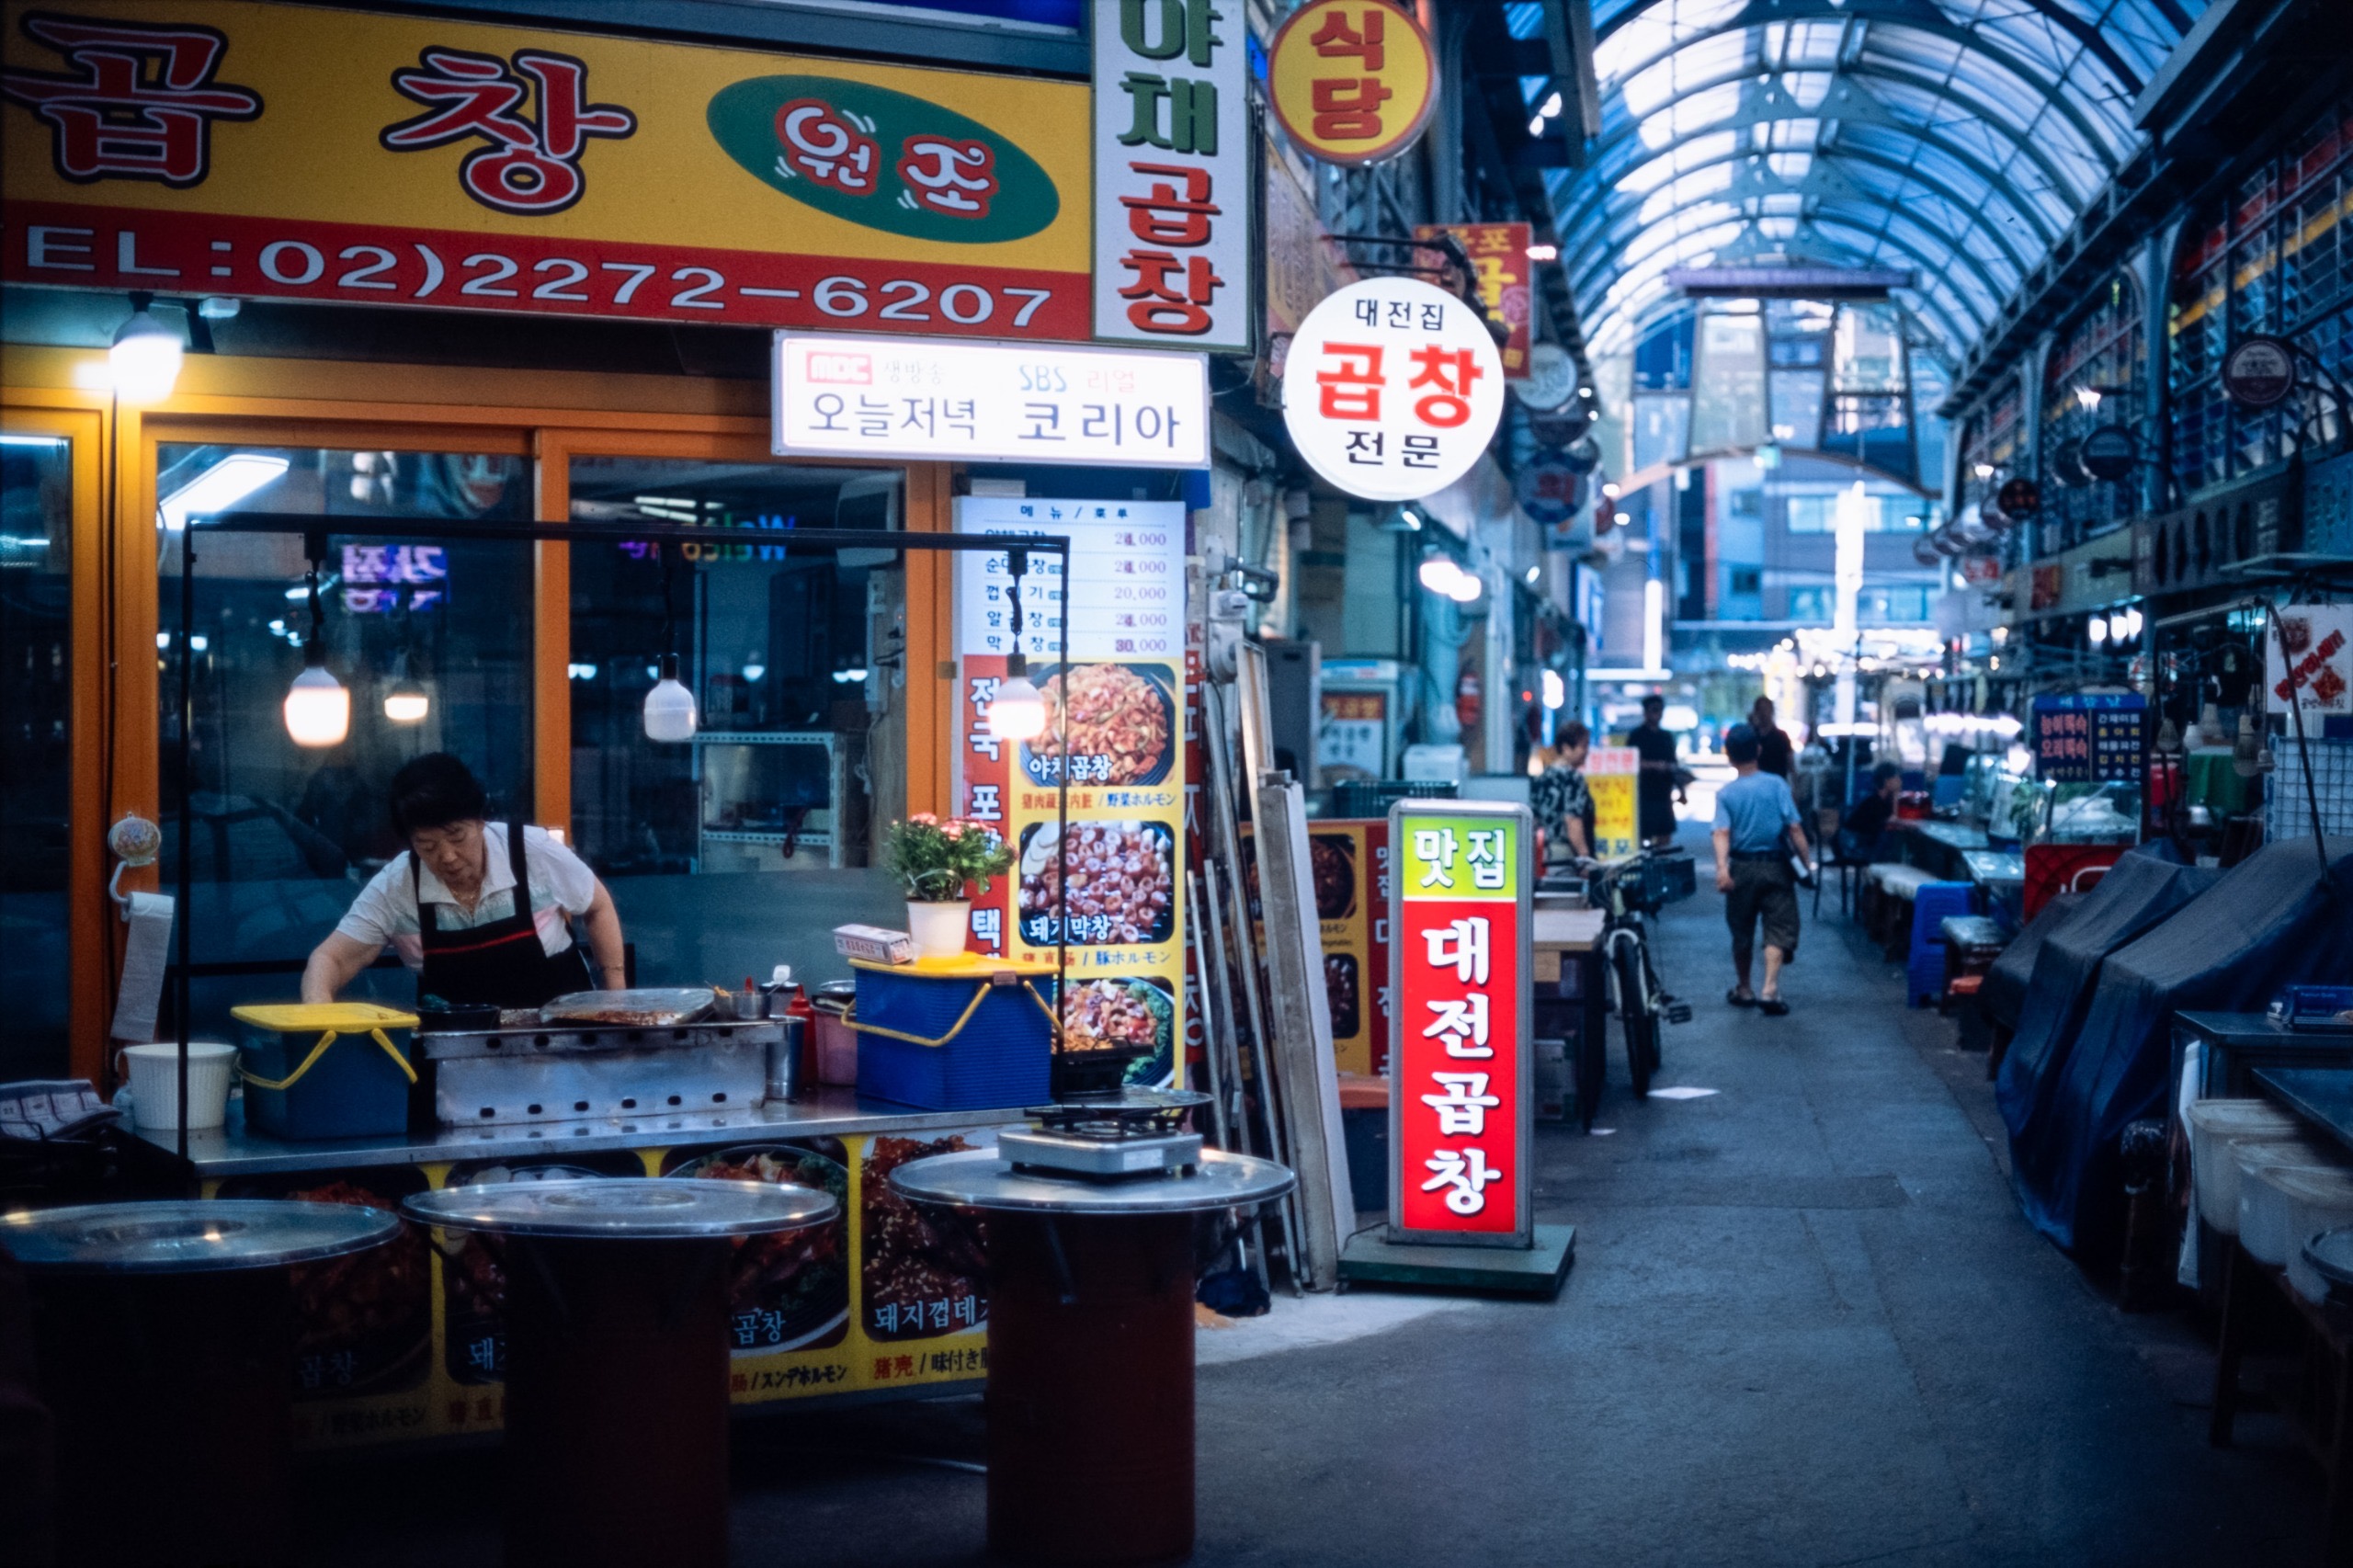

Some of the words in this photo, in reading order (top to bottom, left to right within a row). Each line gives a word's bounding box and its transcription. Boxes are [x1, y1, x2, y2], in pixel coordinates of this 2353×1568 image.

[1117, 0, 1222, 157] 야채
[1311, 10, 1392, 141] 식당
[775, 98, 998, 219] 원조
[1117, 161, 1225, 335] 곱창
[1355, 299, 1444, 331] 대전집
[882, 359, 946, 385] 생방송
[1017, 364, 1067, 392] SBS
[1086, 369, 1135, 392] 리얼
[1316, 341, 1483, 428] 곱창
[809, 392, 975, 440] 오늘저녁
[1017, 402, 1180, 448] 코리아
[1345, 430, 1441, 469] 전문
[985, 554, 1045, 574] 순창
[985, 585, 1042, 600] 껍기
[987, 611, 1043, 627] 알창
[1414, 826, 1505, 889] 맛집
[971, 908, 1001, 959] 택
[1029, 916, 1113, 941] 돼지막창
[1421, 916, 1501, 1216] 대전곱창
[732, 1308, 786, 1345] 곱창
